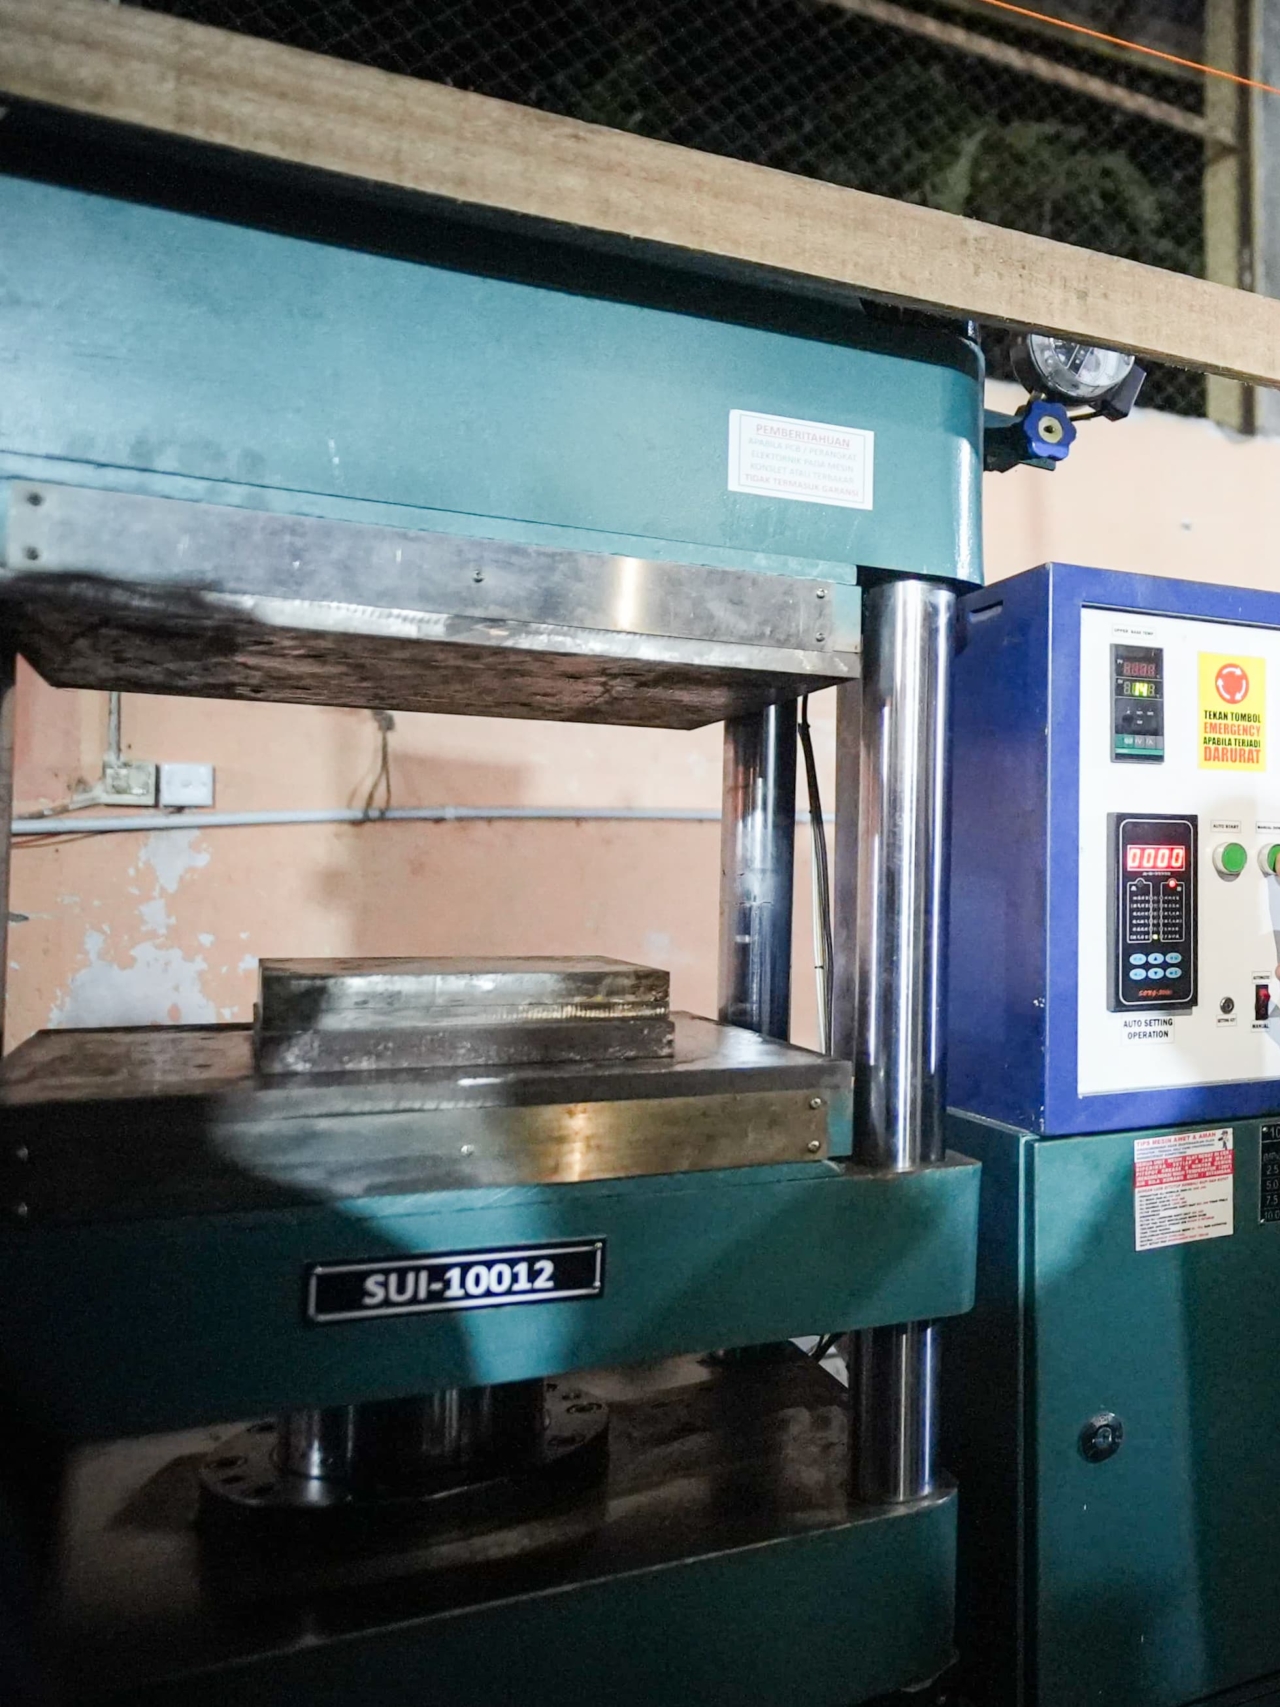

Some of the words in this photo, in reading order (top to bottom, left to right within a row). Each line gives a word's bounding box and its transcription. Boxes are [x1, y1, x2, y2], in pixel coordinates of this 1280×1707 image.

[756, 423, 850, 447] PEMBERITAHUAN
[748, 437, 783, 449] APABILA
[785, 442, 801, 452] PCB
[809, 447, 857, 461] PERANGKAT
[804, 458, 826, 467] PADA
[828, 463, 853, 473] MESIN
[789, 469, 811, 478] ATAU
[812, 471, 854, 484] TERBAKAR
[744, 473, 771, 484] TIDAK
[773, 478, 819, 491] TERMASUK
[822, 485, 859, 498] GARANSI
[1204, 710, 1228, 720] TEKAN
[1230, 712, 1261, 723] TOMBOL
[1204, 722, 1260, 737] EMERGENCY
[1203, 737, 1232, 746] APABILA
[1234, 738, 1260, 748] TERJADI
[1204, 746, 1261, 764] DARURAT
[1130, 848, 1183, 867] 0000
[1123, 1019, 1142, 1028] AUTO
[1144, 1018, 1173, 1027] SETTING
[1127, 1030, 1169, 1039] OPERATION
[362, 1260, 554, 1305] SUI-10012
